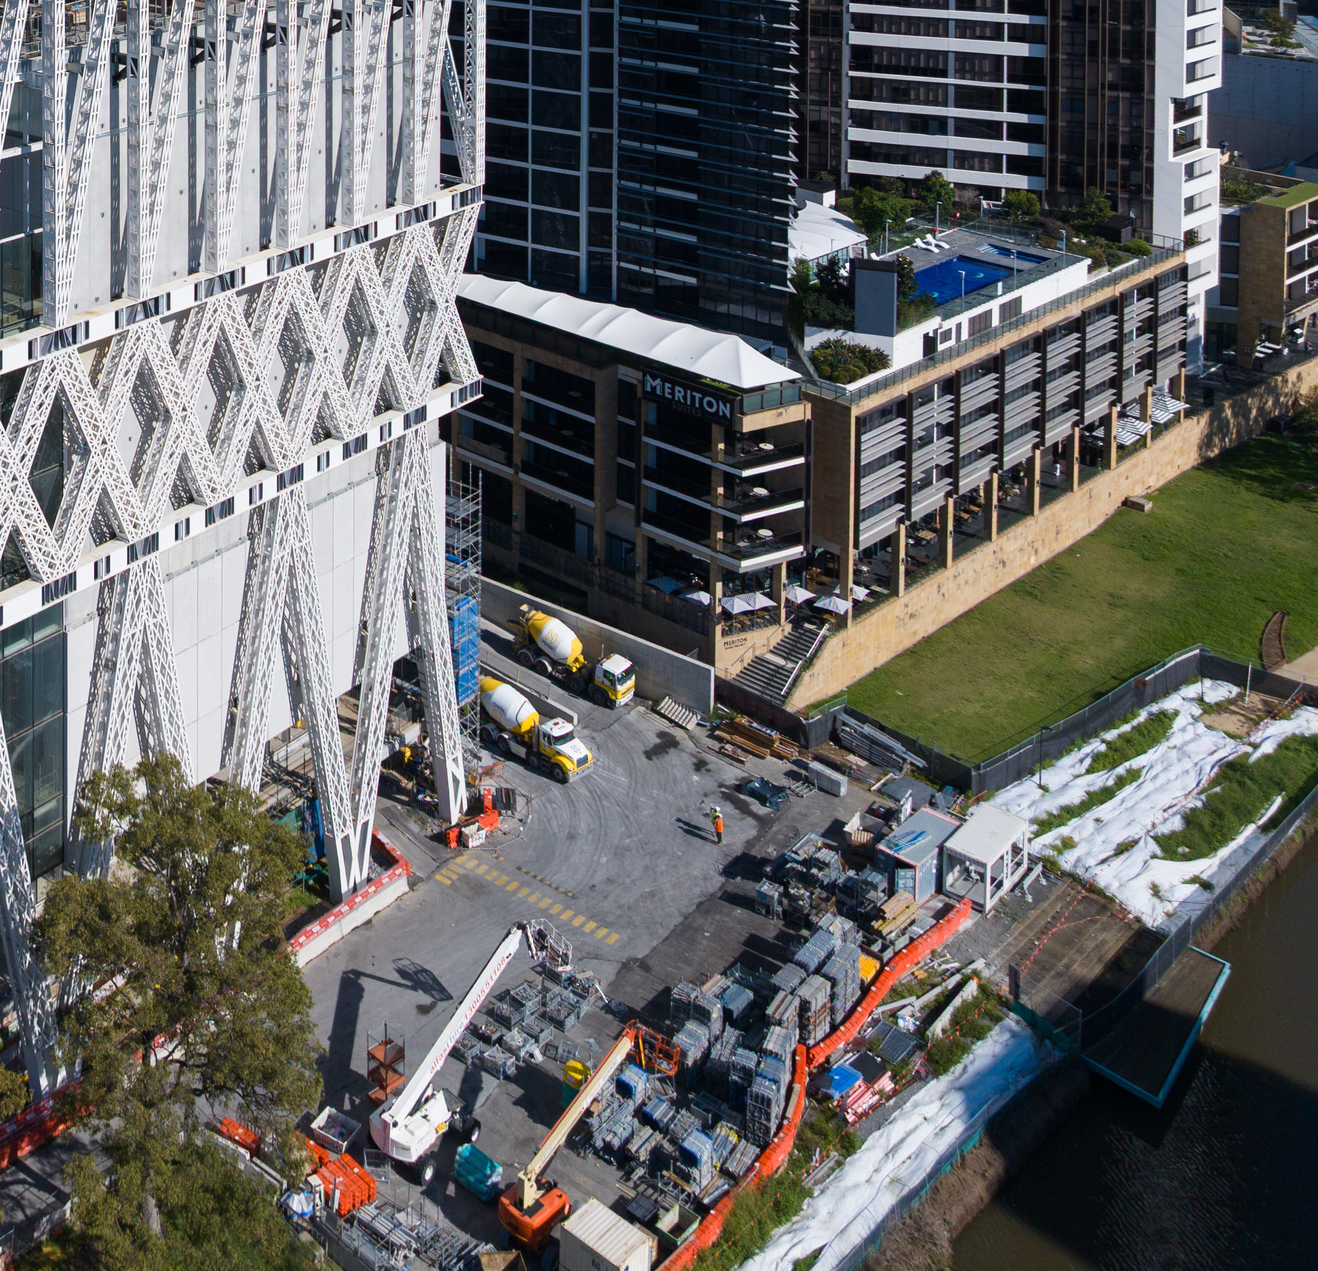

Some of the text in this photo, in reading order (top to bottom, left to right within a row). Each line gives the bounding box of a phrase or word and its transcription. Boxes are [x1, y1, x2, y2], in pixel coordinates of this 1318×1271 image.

[644, 373, 731, 419] MERITON
[671, 400, 702, 418] SUITES
[723, 637, 747, 647] MERITON
